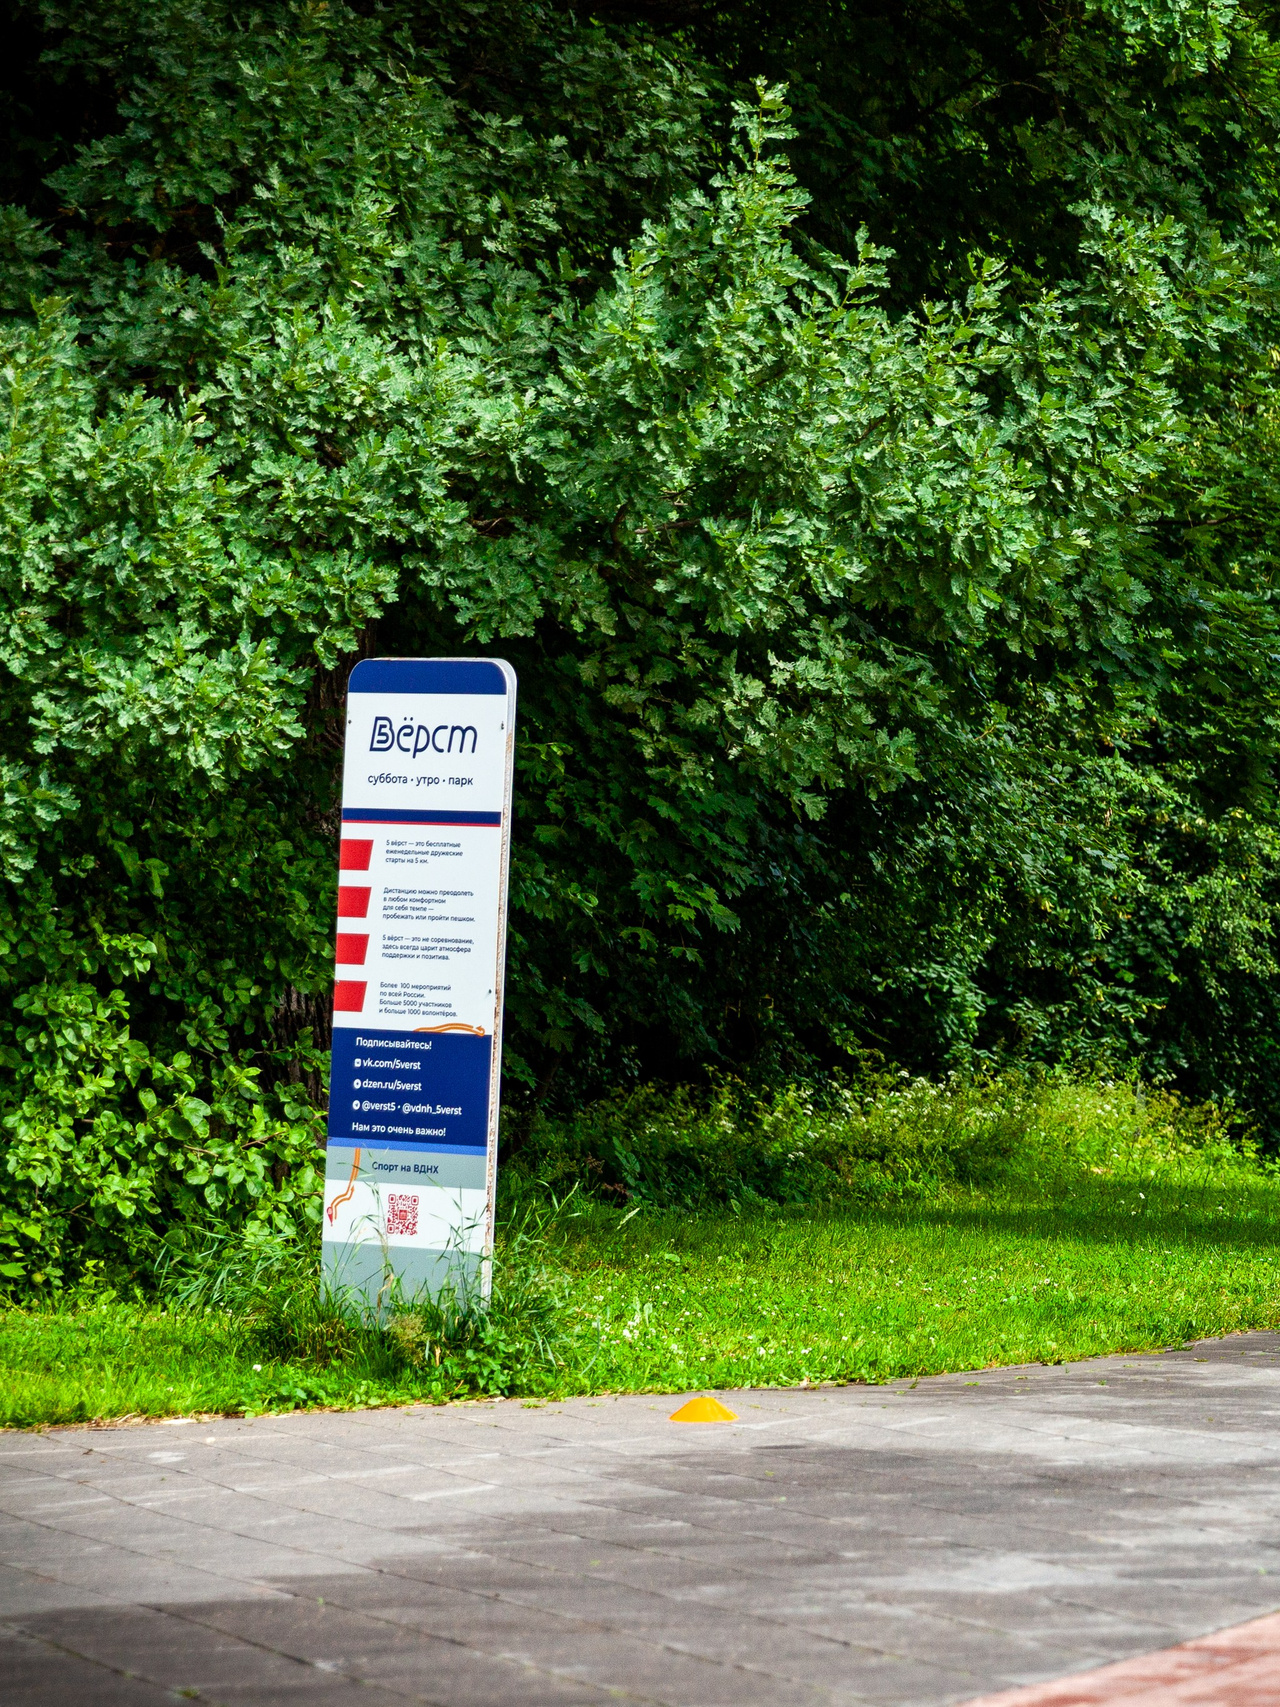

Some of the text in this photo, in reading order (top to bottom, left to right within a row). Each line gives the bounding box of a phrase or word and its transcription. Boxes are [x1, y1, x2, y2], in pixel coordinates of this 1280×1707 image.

[368, 773, 473, 786] суббота утро парк
[356, 1037, 432, 1049] Подписывайтесь!
[363, 1058, 421, 1069] vk.com/5verst
[363, 1079, 422, 1090] dzen.ru/5verst
[362, 1101, 462, 1115] @verst5 @vdnh_5verst
[352, 1122, 370, 1131] Нам
[388, 1126, 413, 1134] очень
[416, 1127, 446, 1136] важно!
[372, 1162, 398, 1173] Спорт
[414, 1164, 439, 1174] ВДНХ
